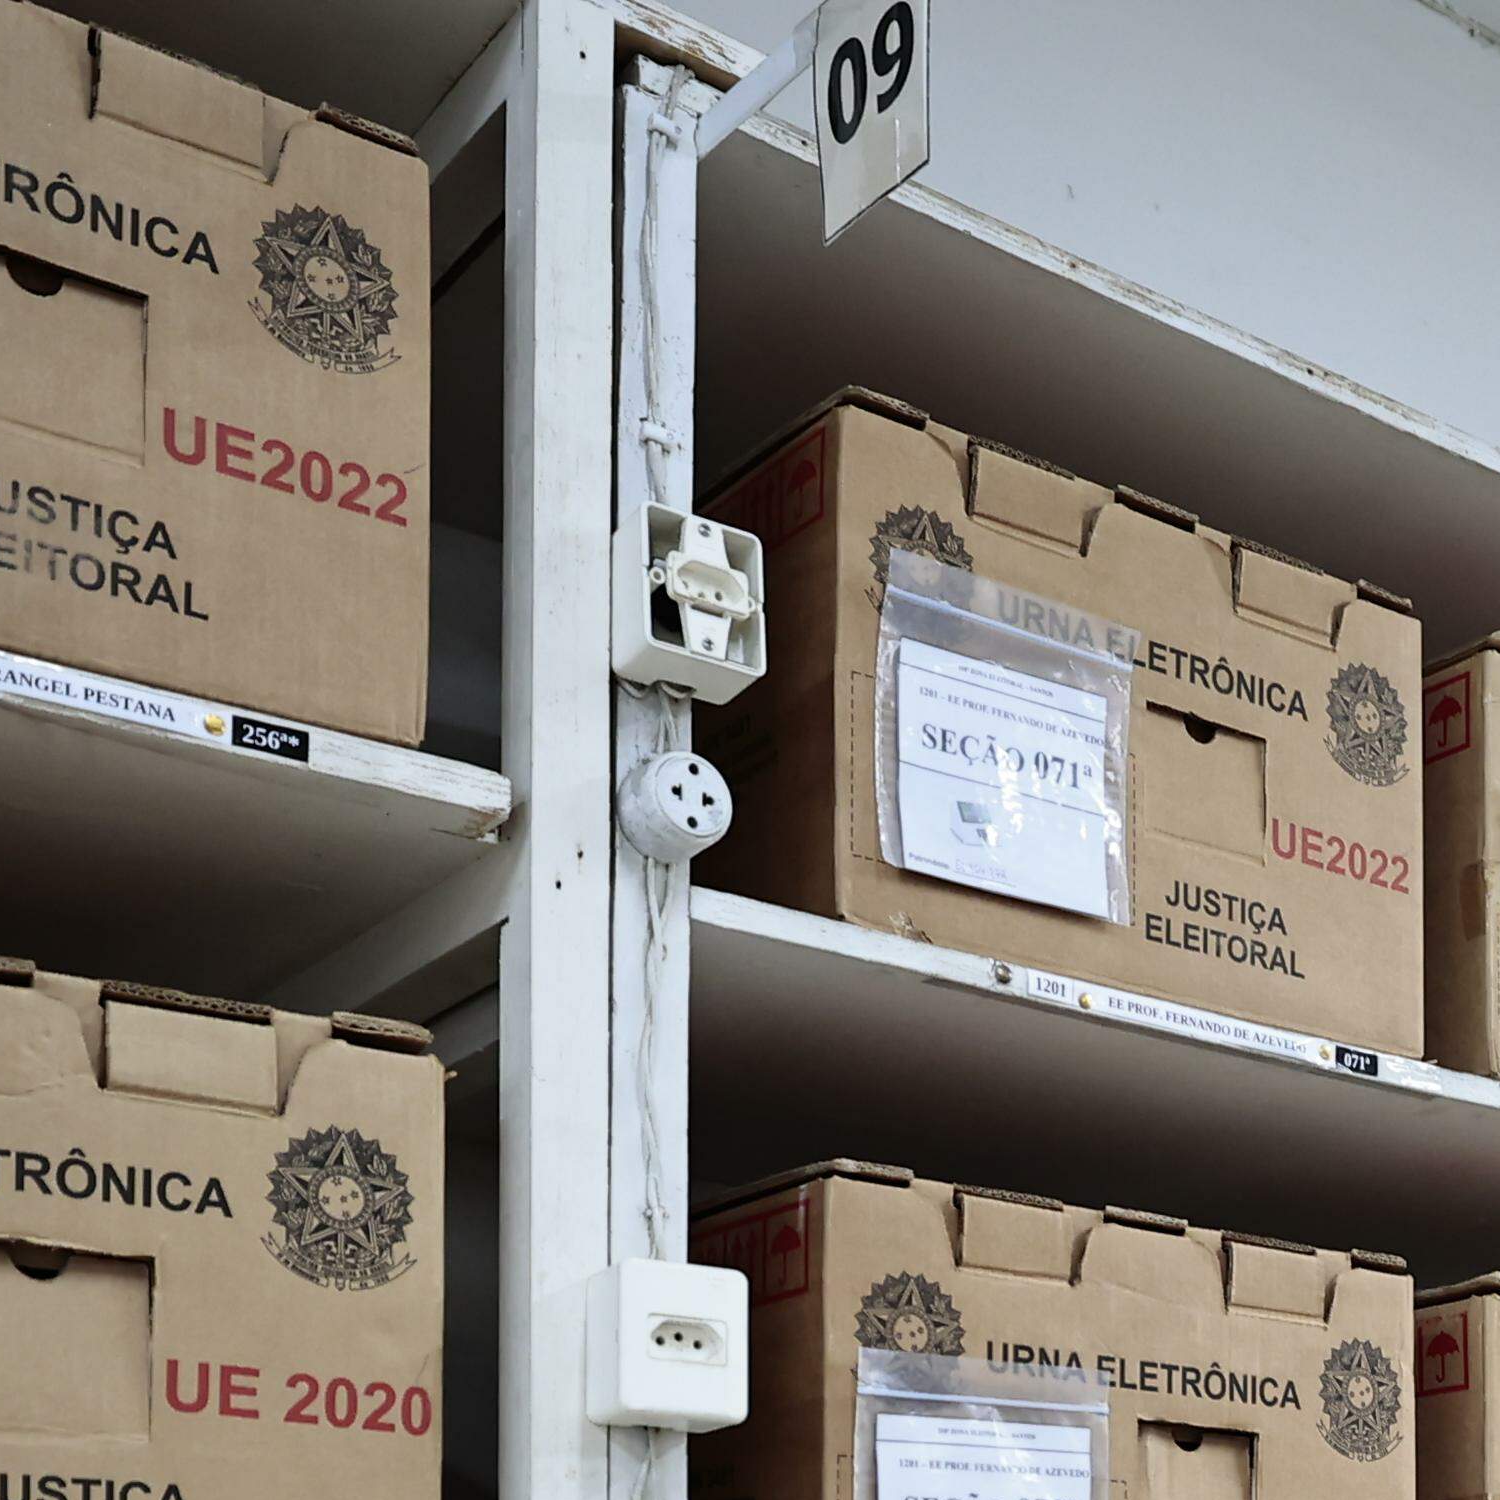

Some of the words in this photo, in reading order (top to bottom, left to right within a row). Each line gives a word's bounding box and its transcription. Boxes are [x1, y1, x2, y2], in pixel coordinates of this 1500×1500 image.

[828, 1, 914, 145] 09
[162, 407, 409, 527] UE2022
[999, 588, 1094, 650] URNA
[1105, 618, 1308, 723] ELETRÔNICA
[83, 686, 176, 723] PESTANA
[921, 722, 1025, 773] SEÇÃO
[1034, 750, 1093, 790] 071ª
[1271, 816, 1411, 895] UE2022
[1164, 879, 1289, 939] JUSTIÇA
[1145, 913, 1306, 981] ELEITORAL
[1035, 975, 1067, 998] 1201
[165, 1358, 261, 1421] UE
[283, 1372, 434, 1438] 2020
[986, 1339, 1086, 1384] URNA
[1097, 1355, 1301, 1411] ELETRÔNICA
